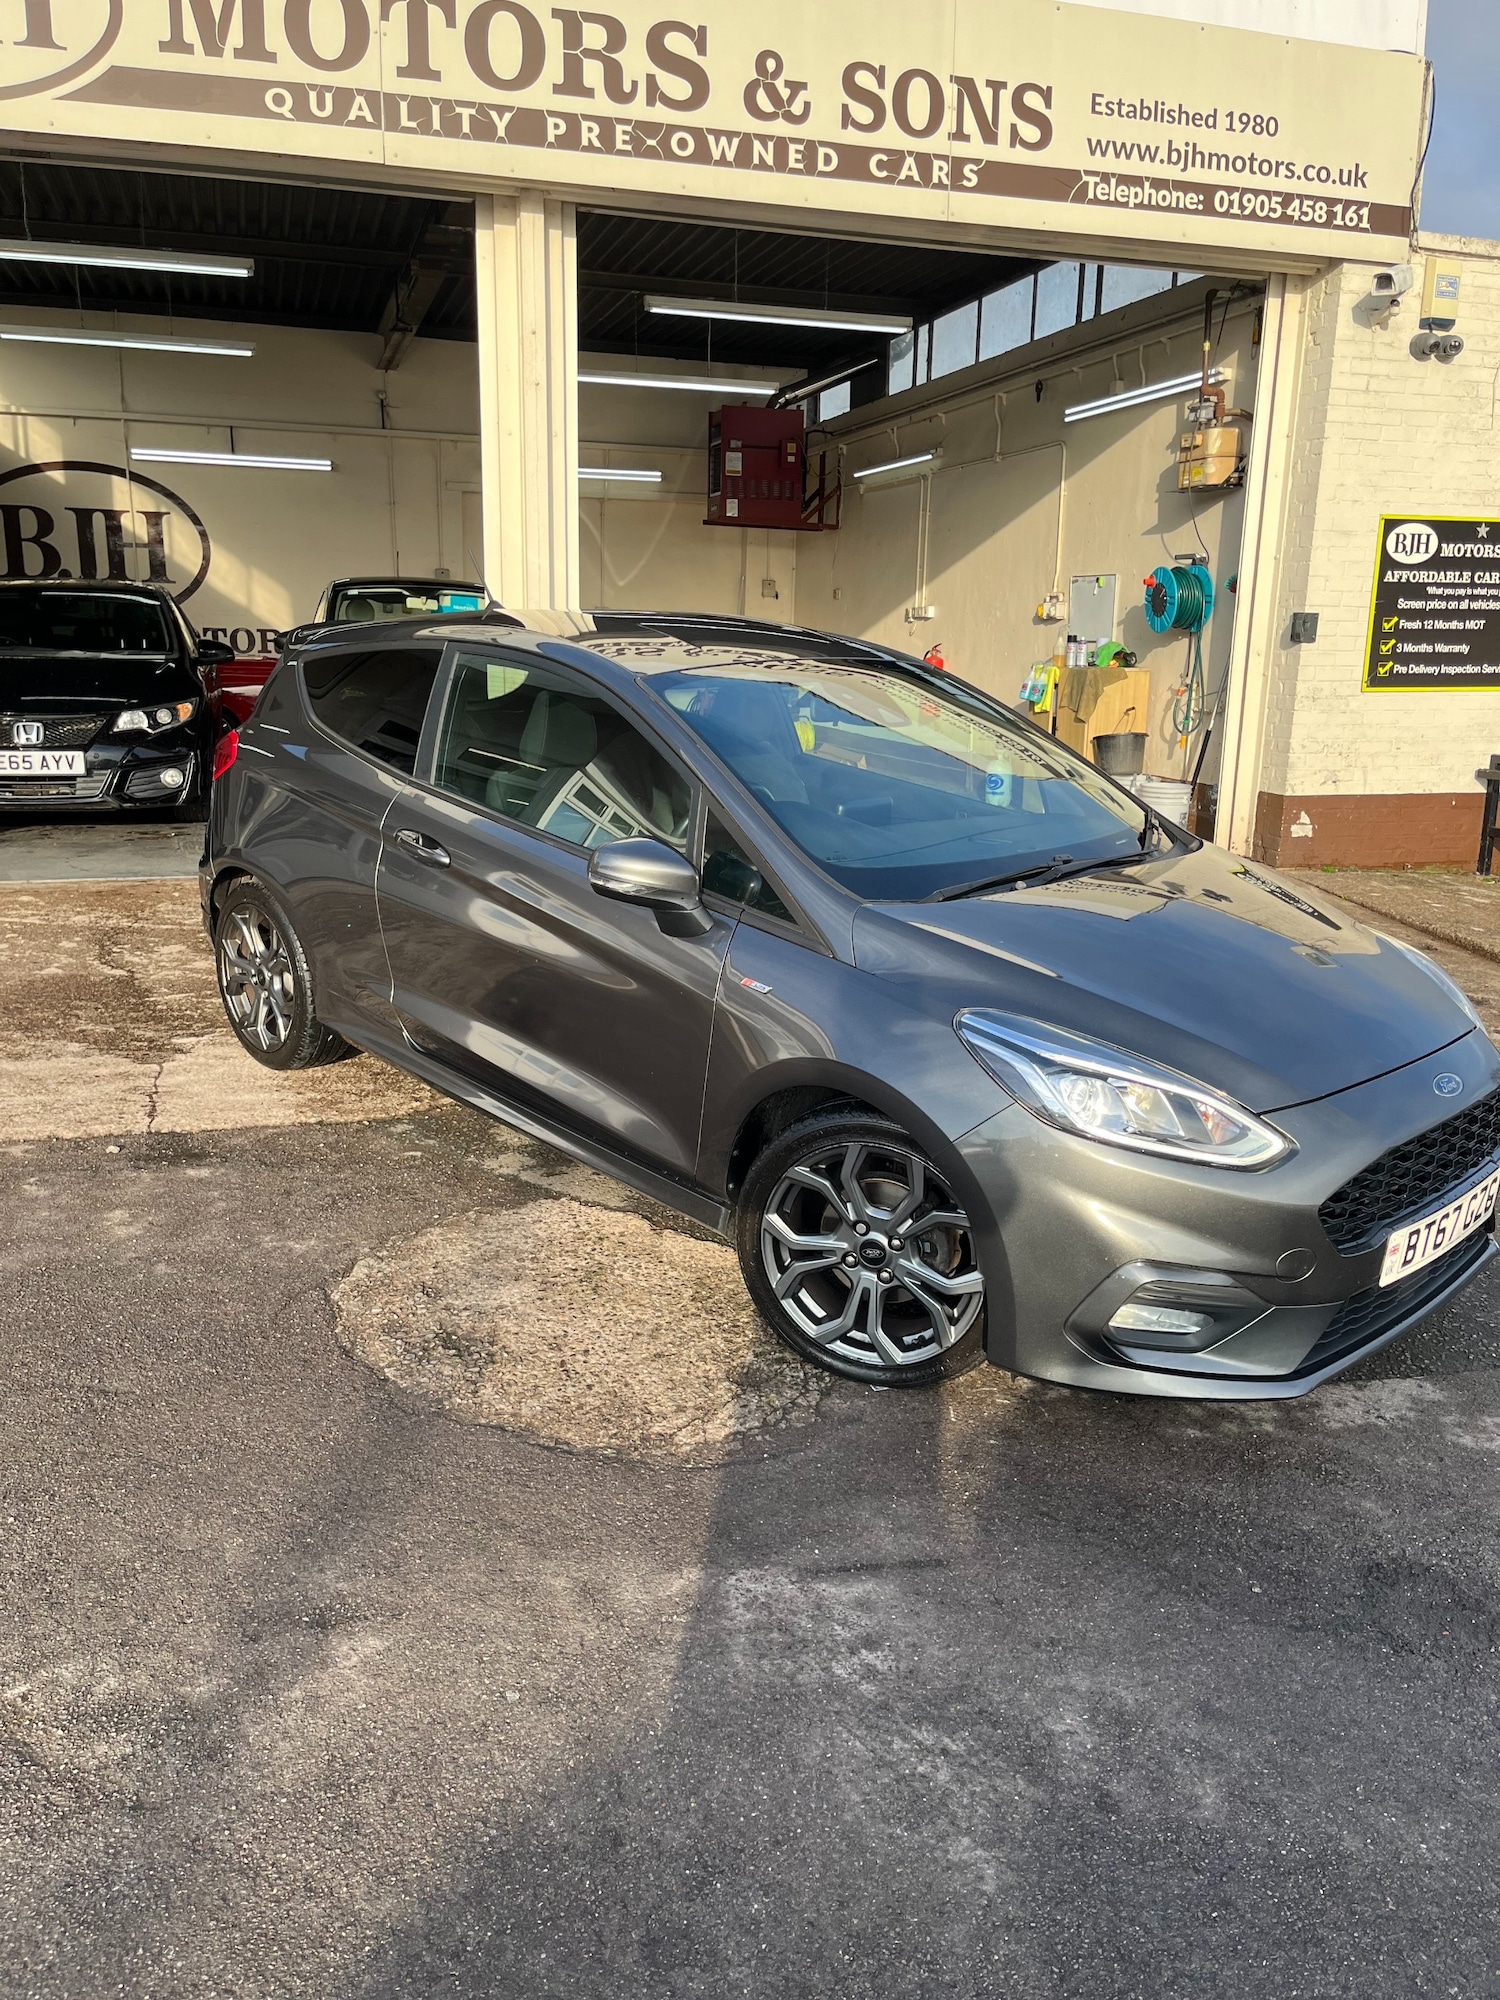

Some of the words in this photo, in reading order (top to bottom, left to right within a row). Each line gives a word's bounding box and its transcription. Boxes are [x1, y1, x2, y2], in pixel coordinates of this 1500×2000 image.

[158, 0, 710, 113] MOTORS
[743, 49, 811, 125] &
[841, 61, 1053, 151] SONS
[1090, 92, 1218, 130] Established
[1225, 111, 1279, 137] 1980
[264, 87, 514, 138] QUALITY
[869, 153, 979, 188] CARS
[1086, 138, 1369, 189] www.bjhmotors.co.uk
[1083, 176, 1205, 211] Telephone:
[1213, 190, 1283, 219] 01905
[1286, 198, 1328, 224] 458
[1332, 203, 1371, 229] 161
[1392, 532, 1433, 557] BJH
[1440, 543, 1500, 558] MOTORS
[1383, 570, 1472, 584] AFFORDABLE
[1474, 571, 1500, 584] CAR
[1443, 588, 1455, 597] you
[1455, 588, 1467, 597] pay
[1467, 587, 1472, 595] is
[1473, 587, 1487, 595] what
[1487, 588, 1499, 597] you
[1397, 598, 1425, 610] Screen
[1426, 599, 1447, 611] price
[1447, 601, 1458, 610] on
[1459, 599, 1469, 610] all
[1470, 599, 1500, 610] vehicles
[1399, 619, 1422, 630] Fresh
[1423, 620, 1433, 630] 12
[1434, 620, 1464, 630] Months
[1465, 620, 1486, 630] MOT
[1396, 643, 1402, 653] 3
[1403, 643, 1433, 653] Months
[1434, 643, 1470, 655] Warranty
[1393, 664, 1407, 674] Pre
[1408, 664, 1440, 676] Delivery
[1441, 664, 1481, 676] Inspection
[41, 755, 75, 770] AYV
[1401, 1203, 1463, 1269] BT67
